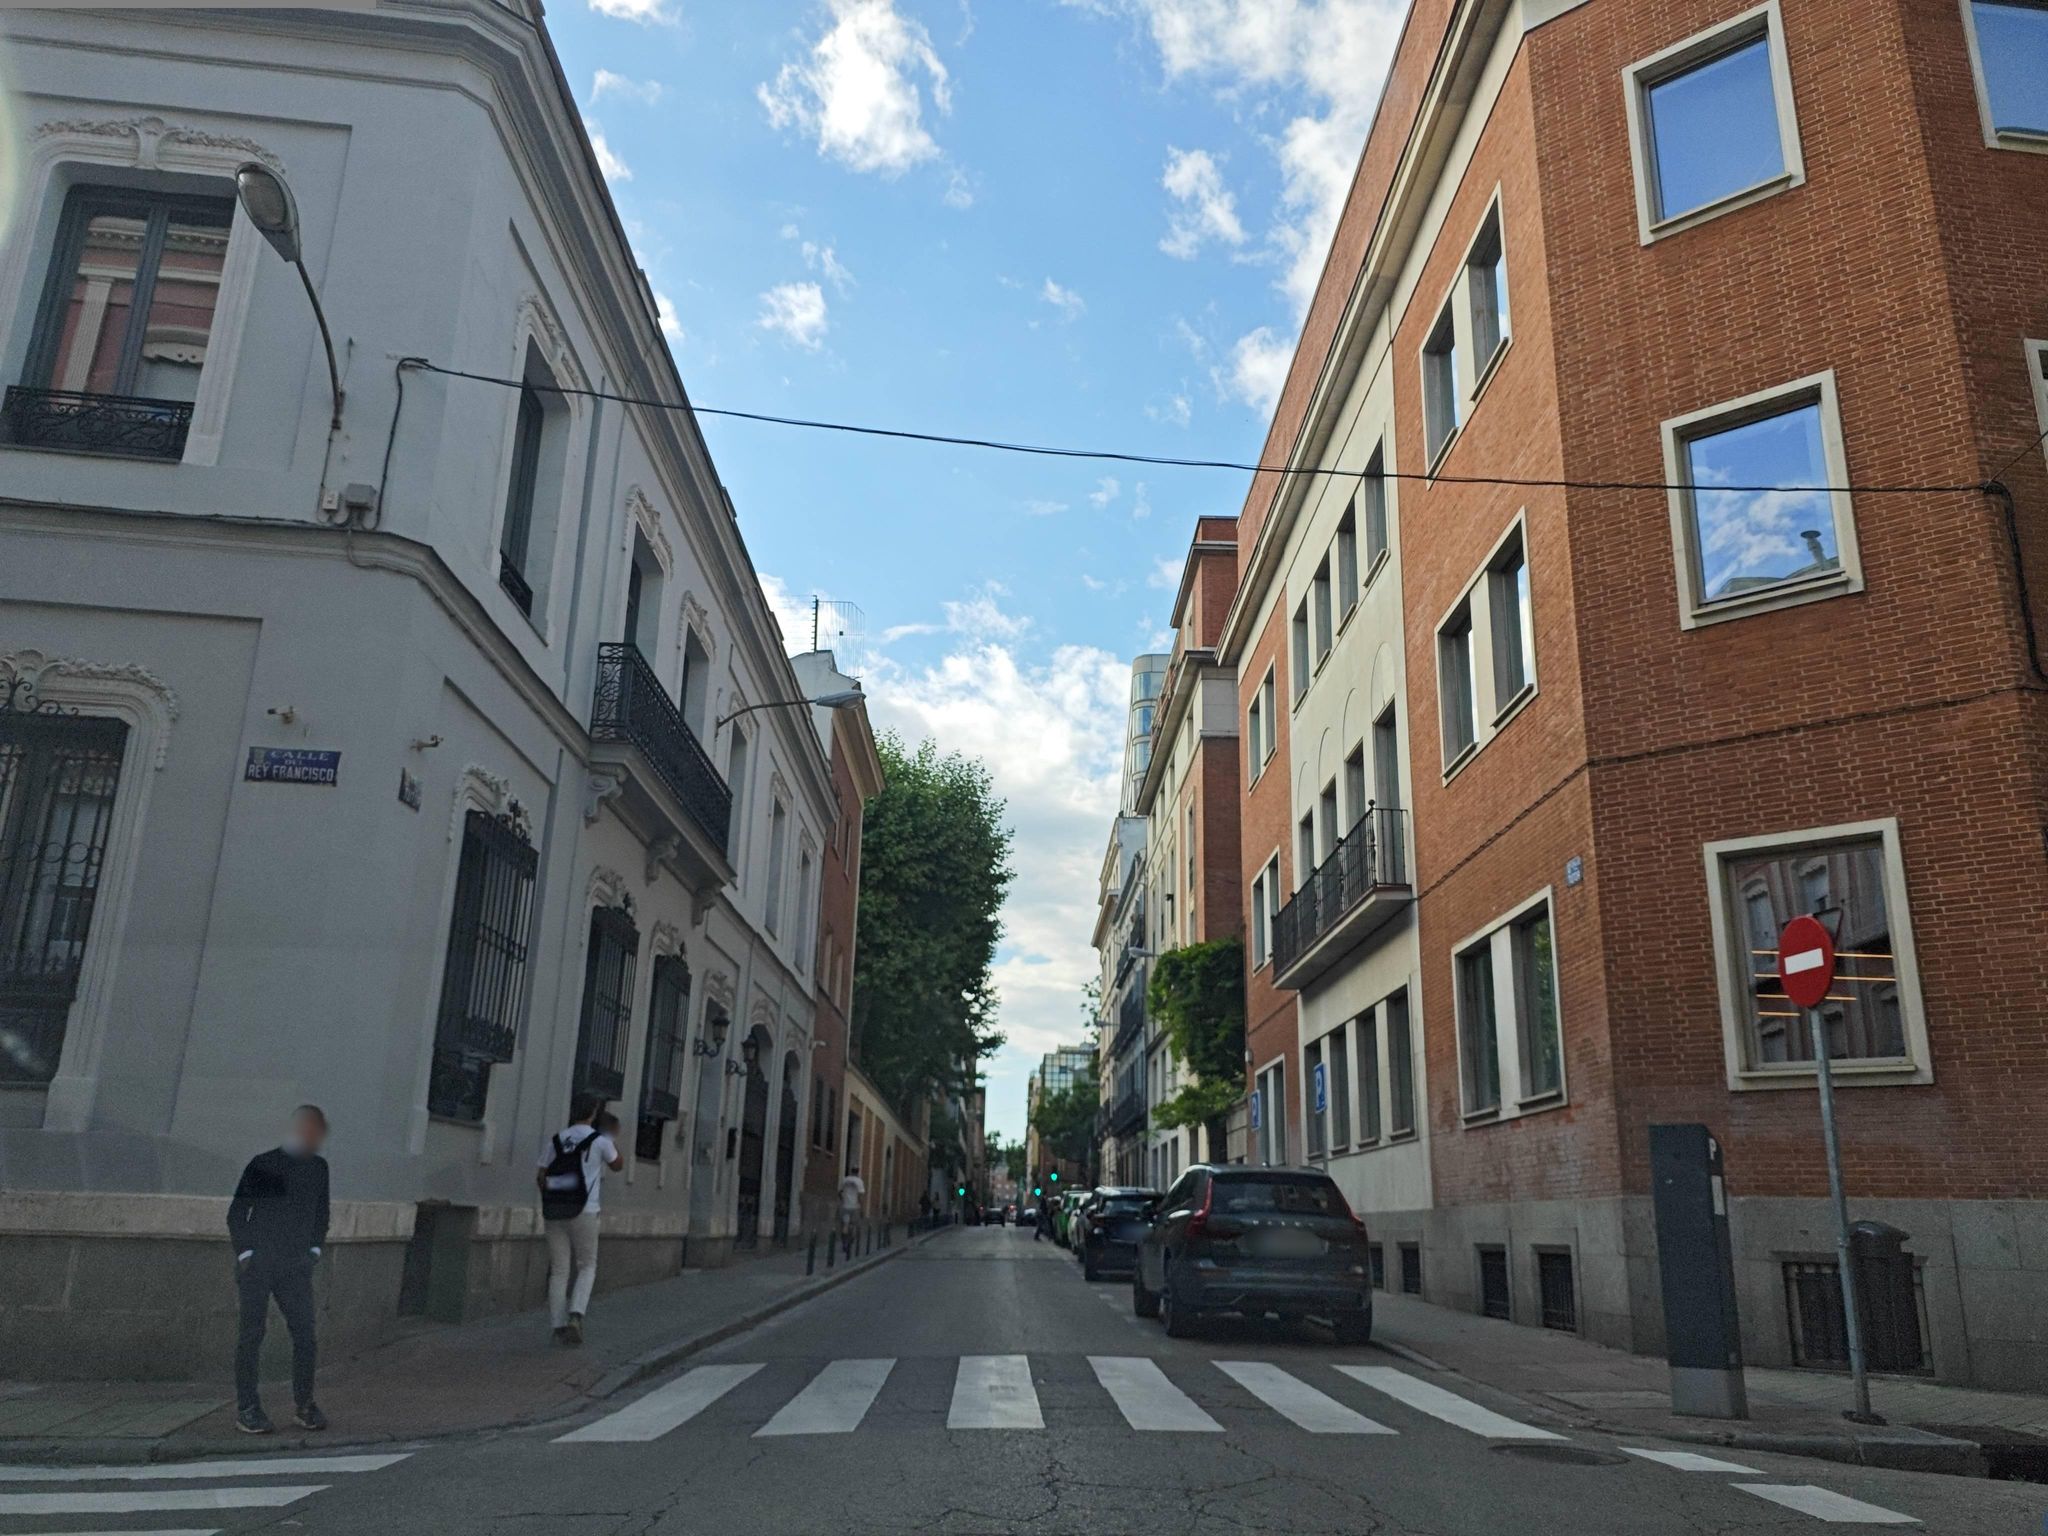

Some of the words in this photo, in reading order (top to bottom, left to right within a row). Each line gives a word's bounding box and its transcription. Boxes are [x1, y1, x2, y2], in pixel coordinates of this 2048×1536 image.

[271, 751, 329, 760] CALLE
[249, 764, 269, 777] REY
[273, 765, 334, 781] FRANCISCO
[1709, 1138, 1717, 1160] P
